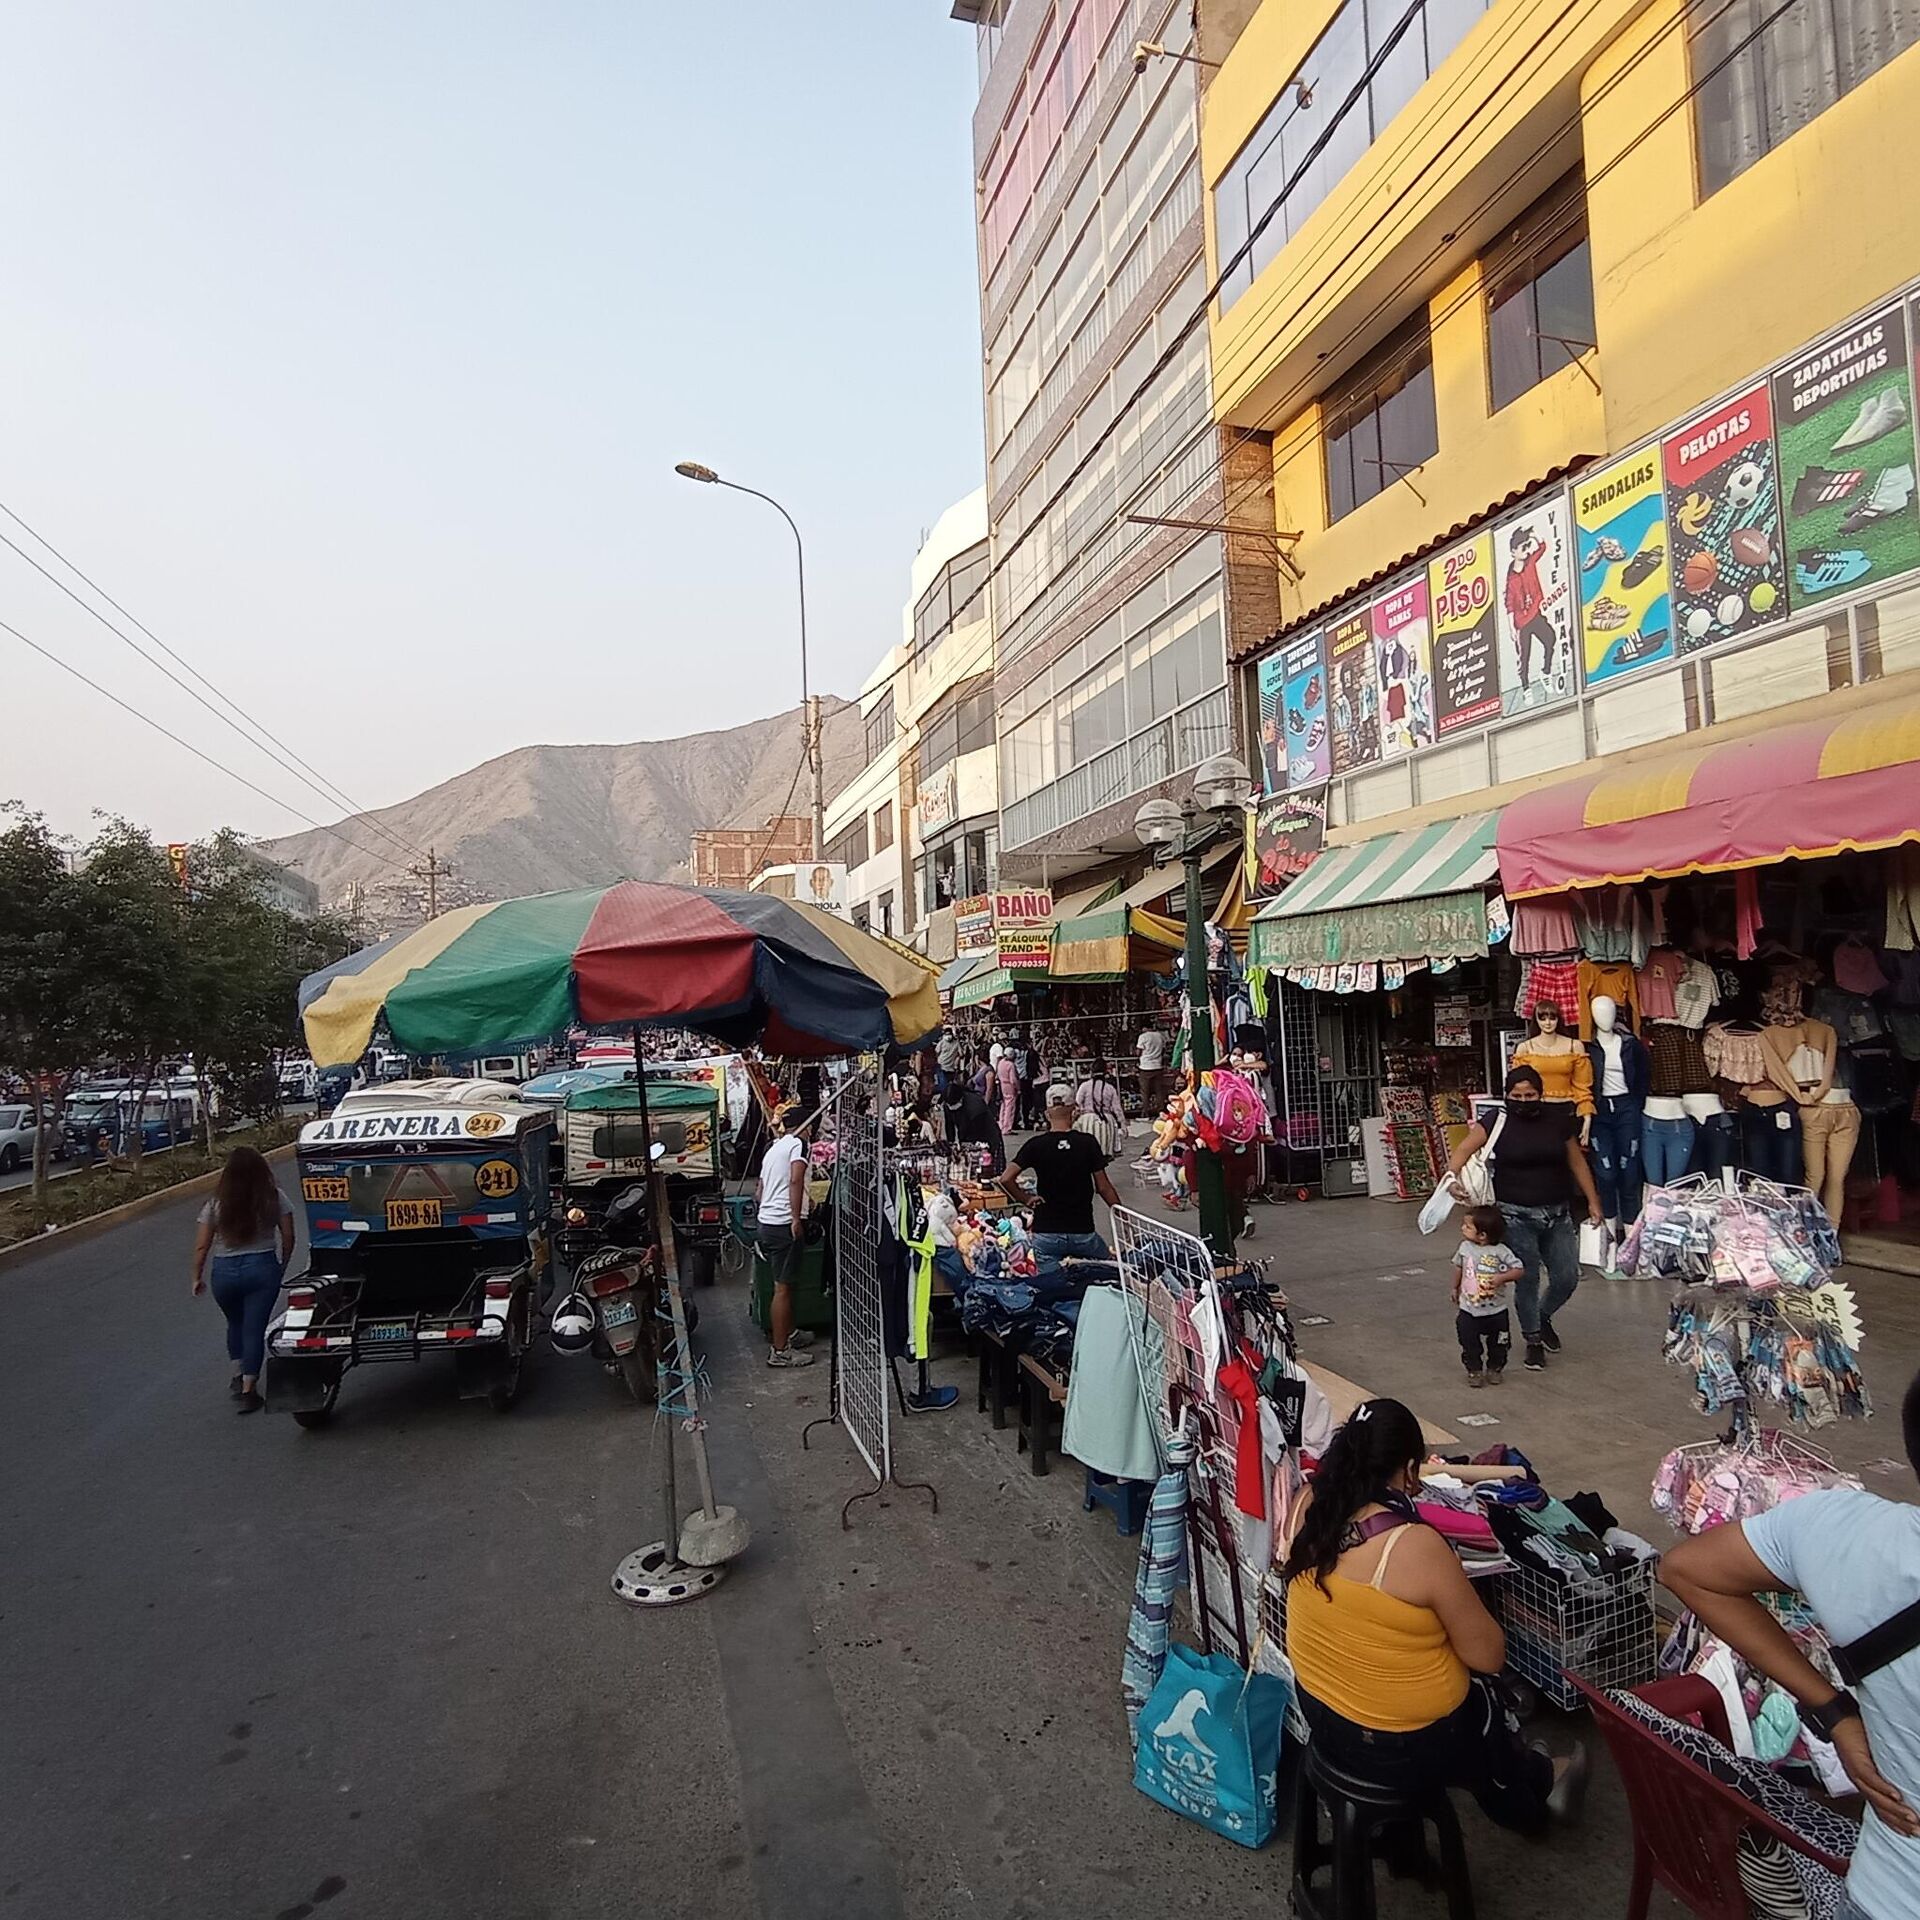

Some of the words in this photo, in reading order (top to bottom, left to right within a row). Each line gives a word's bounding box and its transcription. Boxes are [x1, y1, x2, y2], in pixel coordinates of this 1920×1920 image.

[1792, 325, 1884, 389] ZAPATILLAS
[1793, 348, 1888, 413] DEPORTIVAS
[1679, 409, 1751, 465] PELOTAS
[1582, 462, 1654, 515] SANDALIAS
[1548, 511, 1561, 584] VISTE
[1436, 576, 1487, 625] PISO
[1542, 582, 1568, 612] DONDE
[1554, 607, 1569, 691] MARIO
[996, 891, 1052, 917] BAÑO
[999, 935, 1010, 943] SE
[1010, 935, 1048, 943] ALQUILA
[1000, 944, 1033, 953] STAND
[1001, 960, 1049, 968] 940780350
[312, 1116, 461, 1140] ARENERA
[466, 1117, 501, 1132] 241
[479, 1166, 515, 1191] 241
